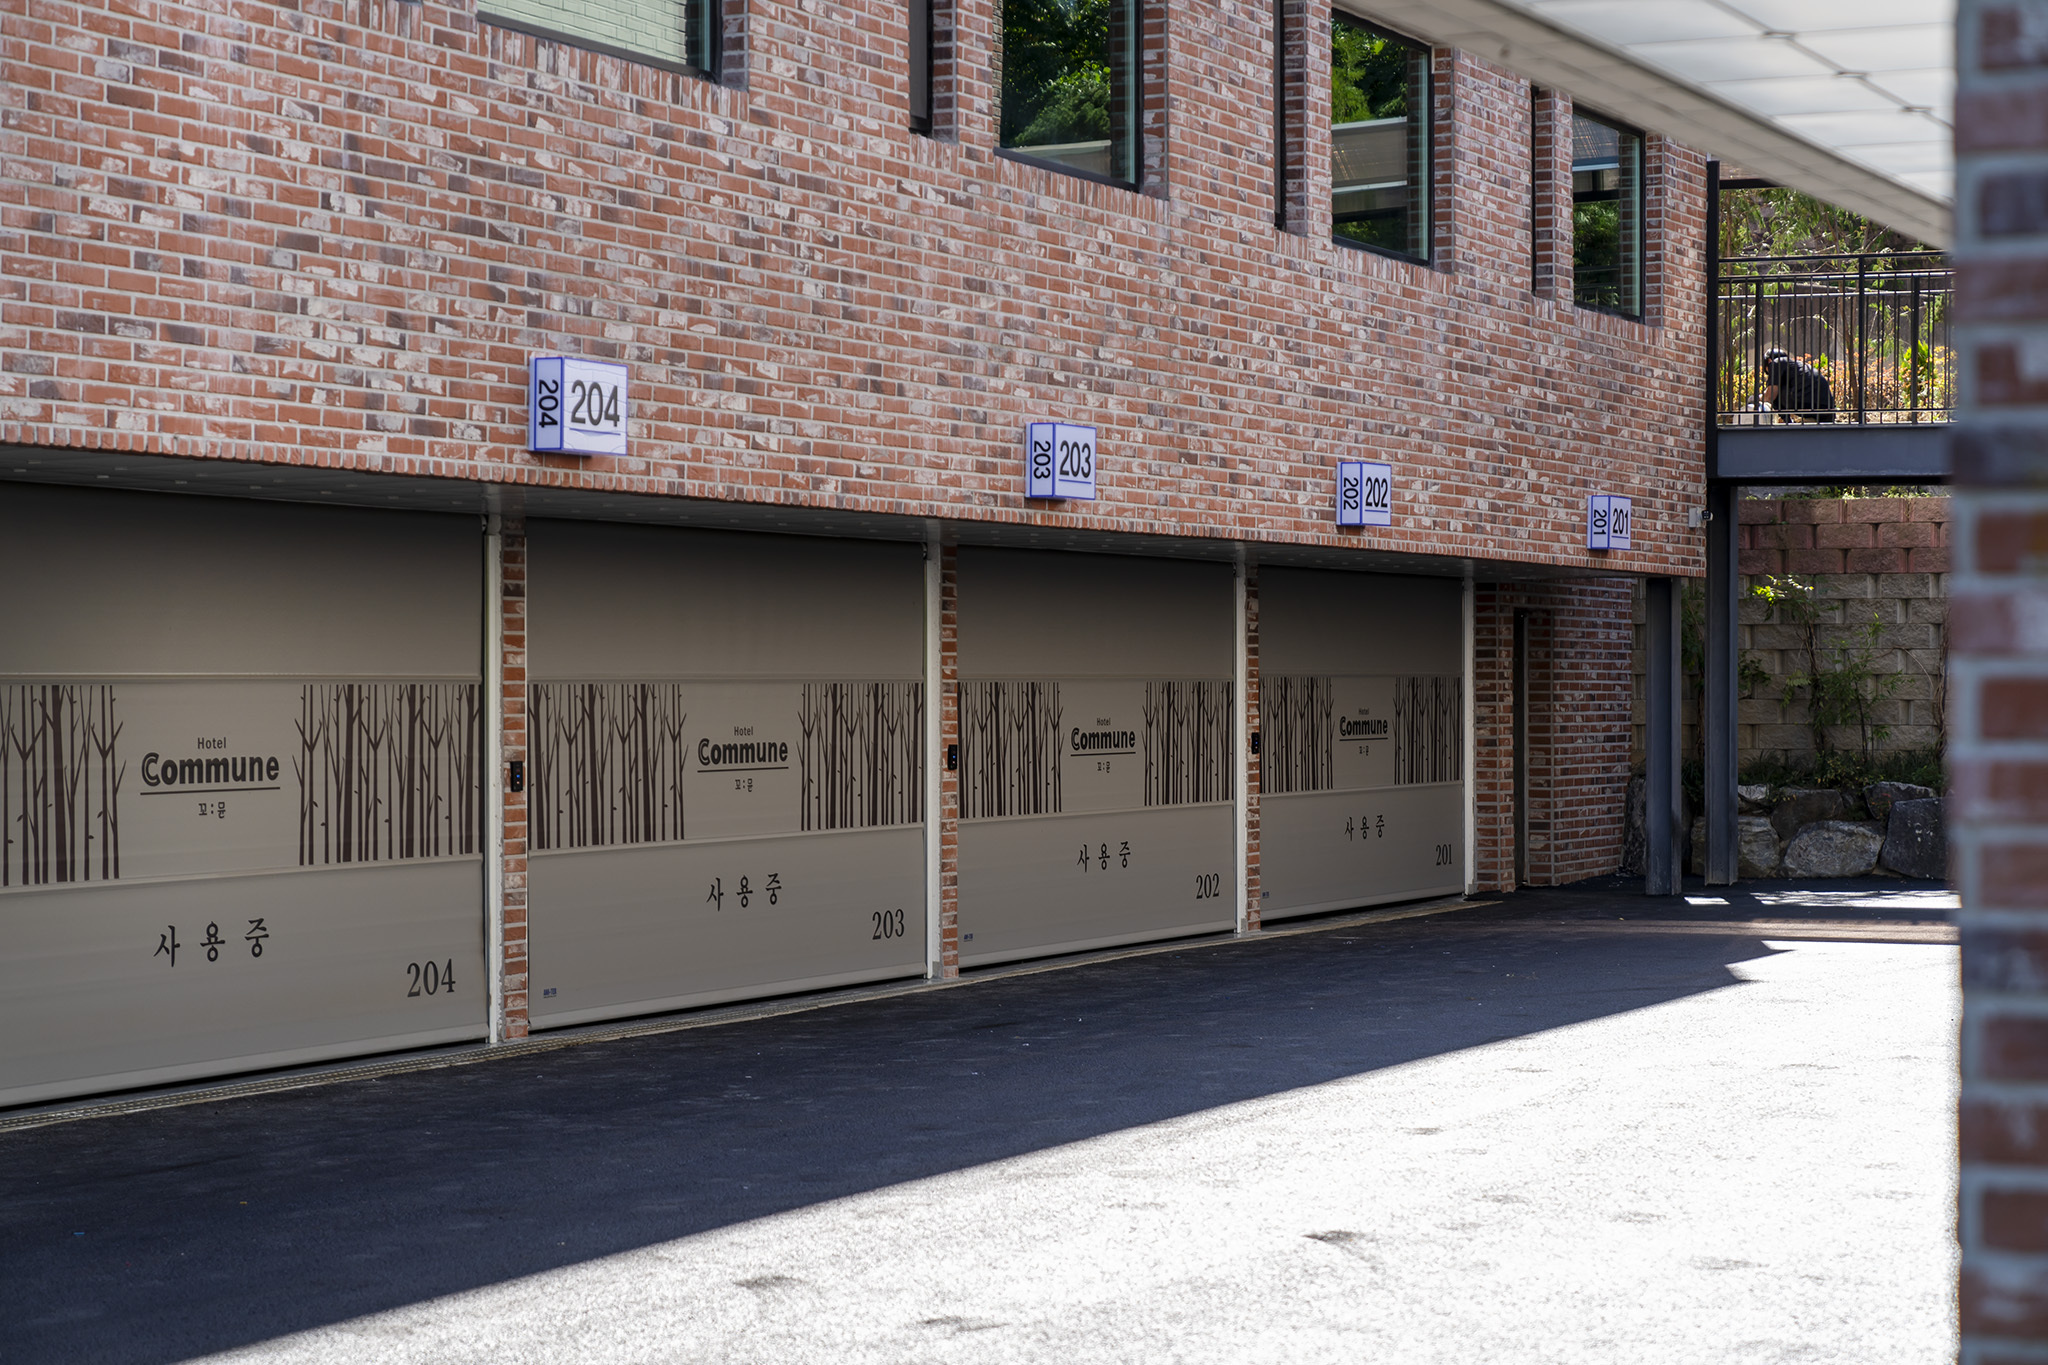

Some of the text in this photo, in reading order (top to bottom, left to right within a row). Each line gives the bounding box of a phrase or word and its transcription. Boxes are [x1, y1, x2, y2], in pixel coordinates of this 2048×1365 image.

[538, 379, 559, 428] 204
[570, 379, 620, 428] 204
[1033, 440, 1052, 480] 203
[1059, 440, 1092, 479] 203
[1343, 476, 1359, 511] 202
[1365, 476, 1389, 508] 202
[1593, 508, 1608, 535] 201
[1612, 507, 1629, 535] 201
[733, 725, 754, 737] Hotel
[1096, 717, 1111, 726] Hotel
[1340, 716, 1388, 736] Commune
[197, 736, 227, 750] Hotel
[697, 737, 789, 766] Commune
[1070, 727, 1136, 751] Commune
[141, 752, 280, 787] Commune
[1435, 843, 1453, 867] 201
[1195, 872, 1220, 900] 202
[872, 908, 905, 941] 203
[406, 958, 457, 998] 204
